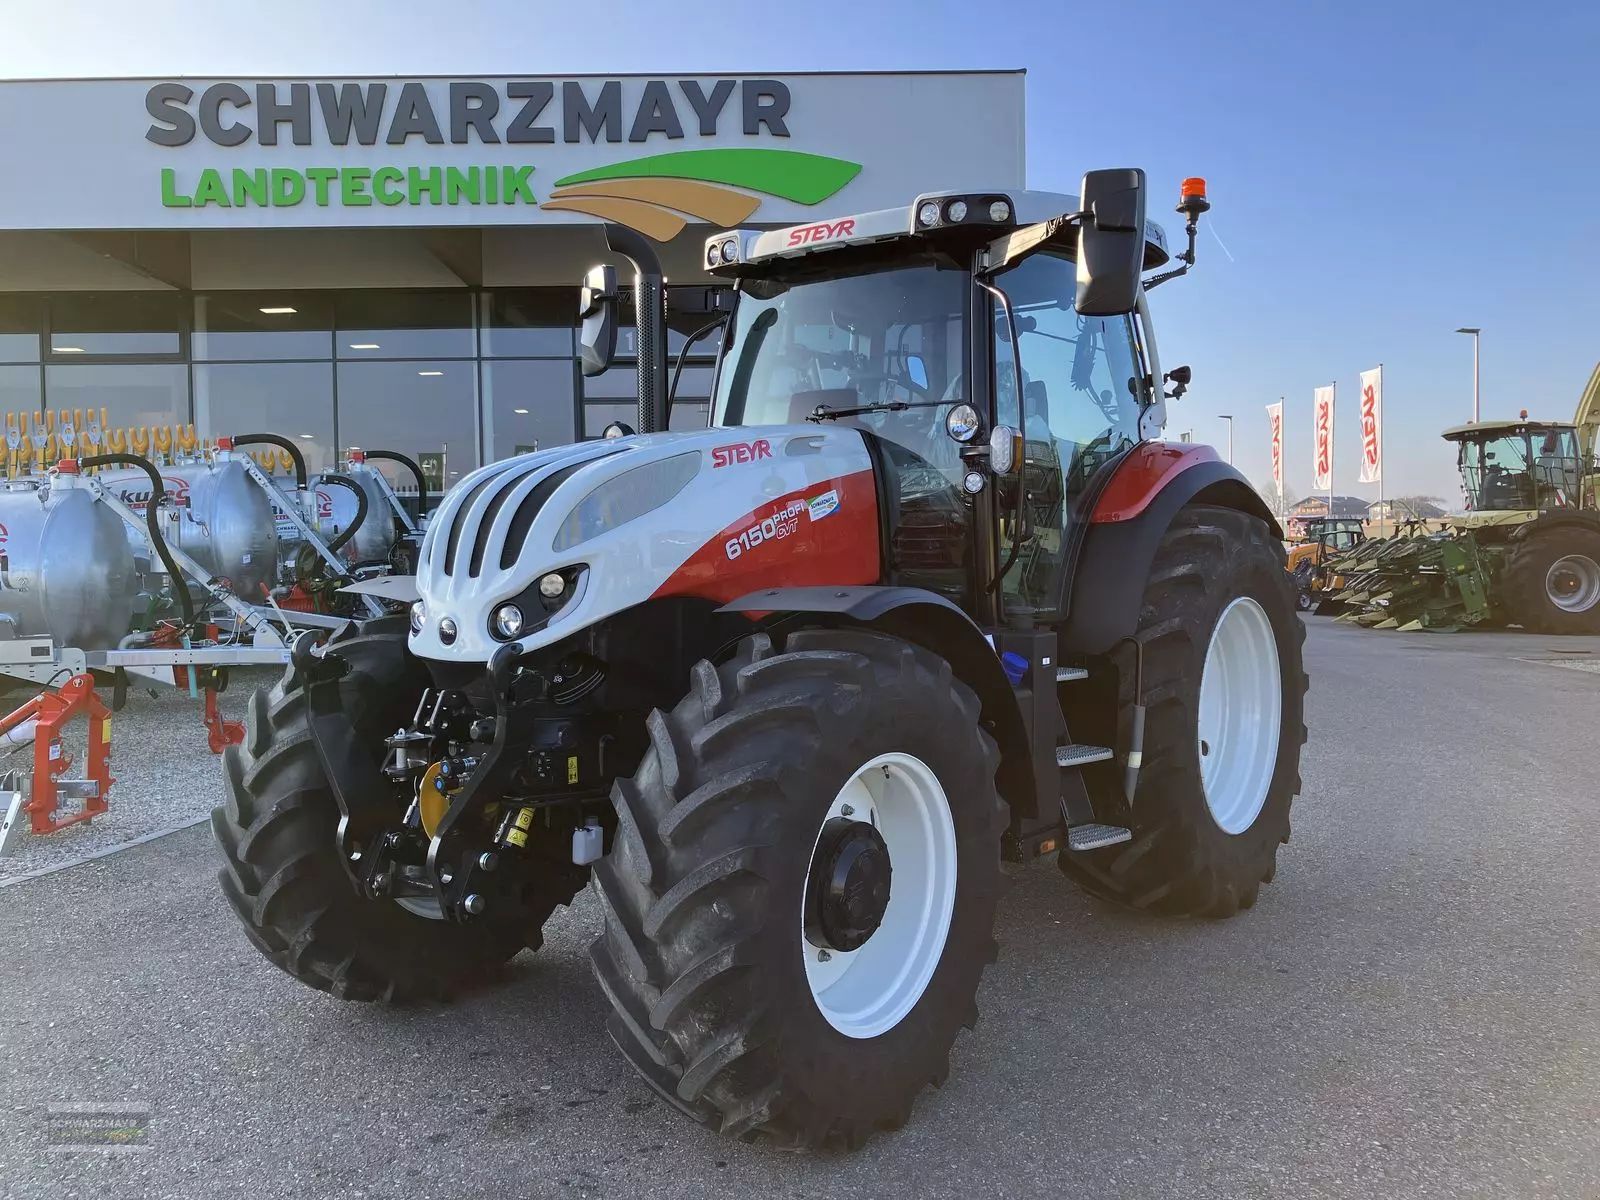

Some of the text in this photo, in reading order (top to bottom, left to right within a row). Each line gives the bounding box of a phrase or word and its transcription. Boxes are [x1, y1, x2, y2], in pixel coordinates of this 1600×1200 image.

[145, 78, 793, 147] SCHWARZMAYR
[160, 164, 537, 208] LANDTECHNIK
[787, 219, 855, 246] STEYR
[712, 440, 772, 467] STEYR
[725, 502, 805, 560] 6150 PROFI
[776, 518, 799, 540] CVT
